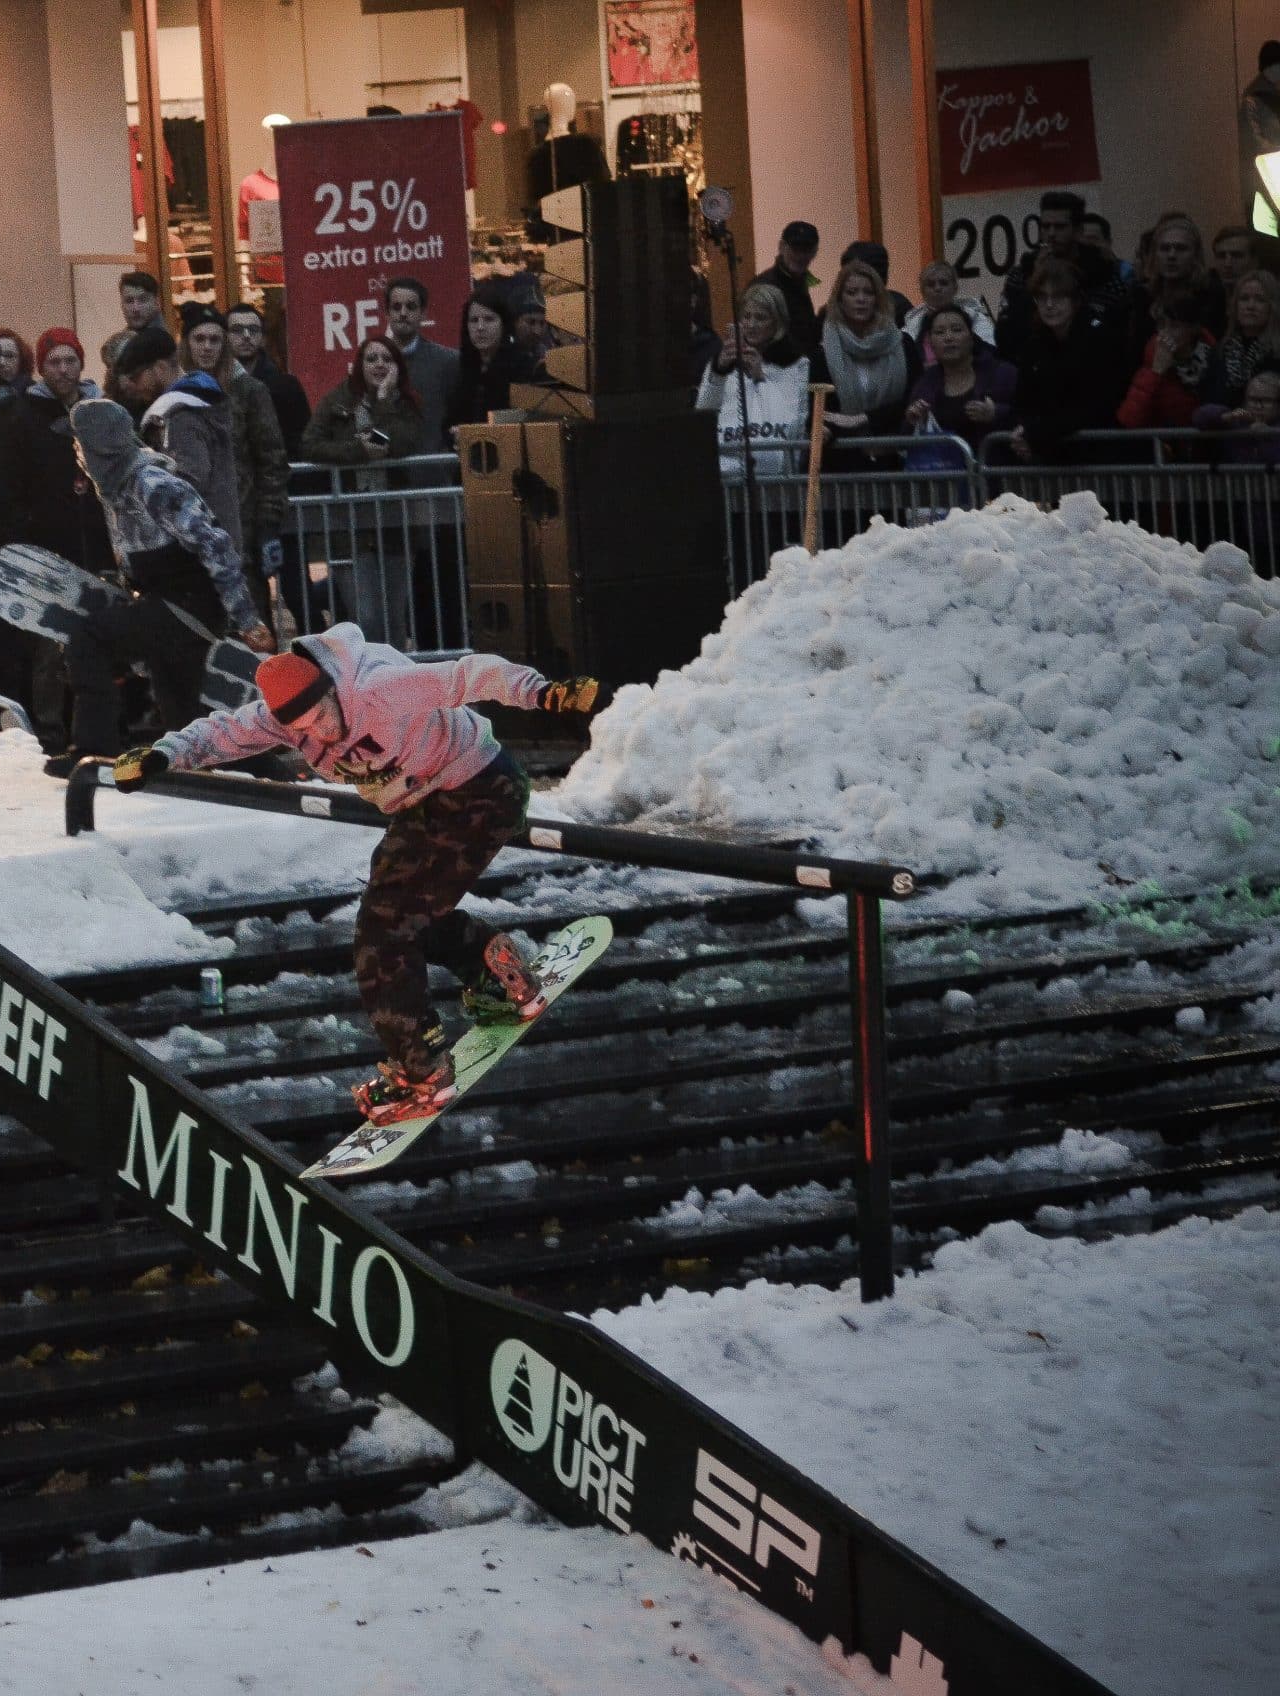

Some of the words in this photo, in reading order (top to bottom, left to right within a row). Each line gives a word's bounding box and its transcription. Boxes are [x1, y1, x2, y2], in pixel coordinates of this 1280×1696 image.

[1024, 85, 1039, 105] &
[959, 105, 1070, 176] Jackor
[314, 178, 428, 235] 25%
[303, 244, 368, 271] extra
[373, 235, 444, 264] rabatt
[118, 1075, 416, 1368] MINIO
[556, 1371, 647, 1481] PICT
[553, 1424, 635, 1536] URE
[693, 1448, 821, 1577] SP
